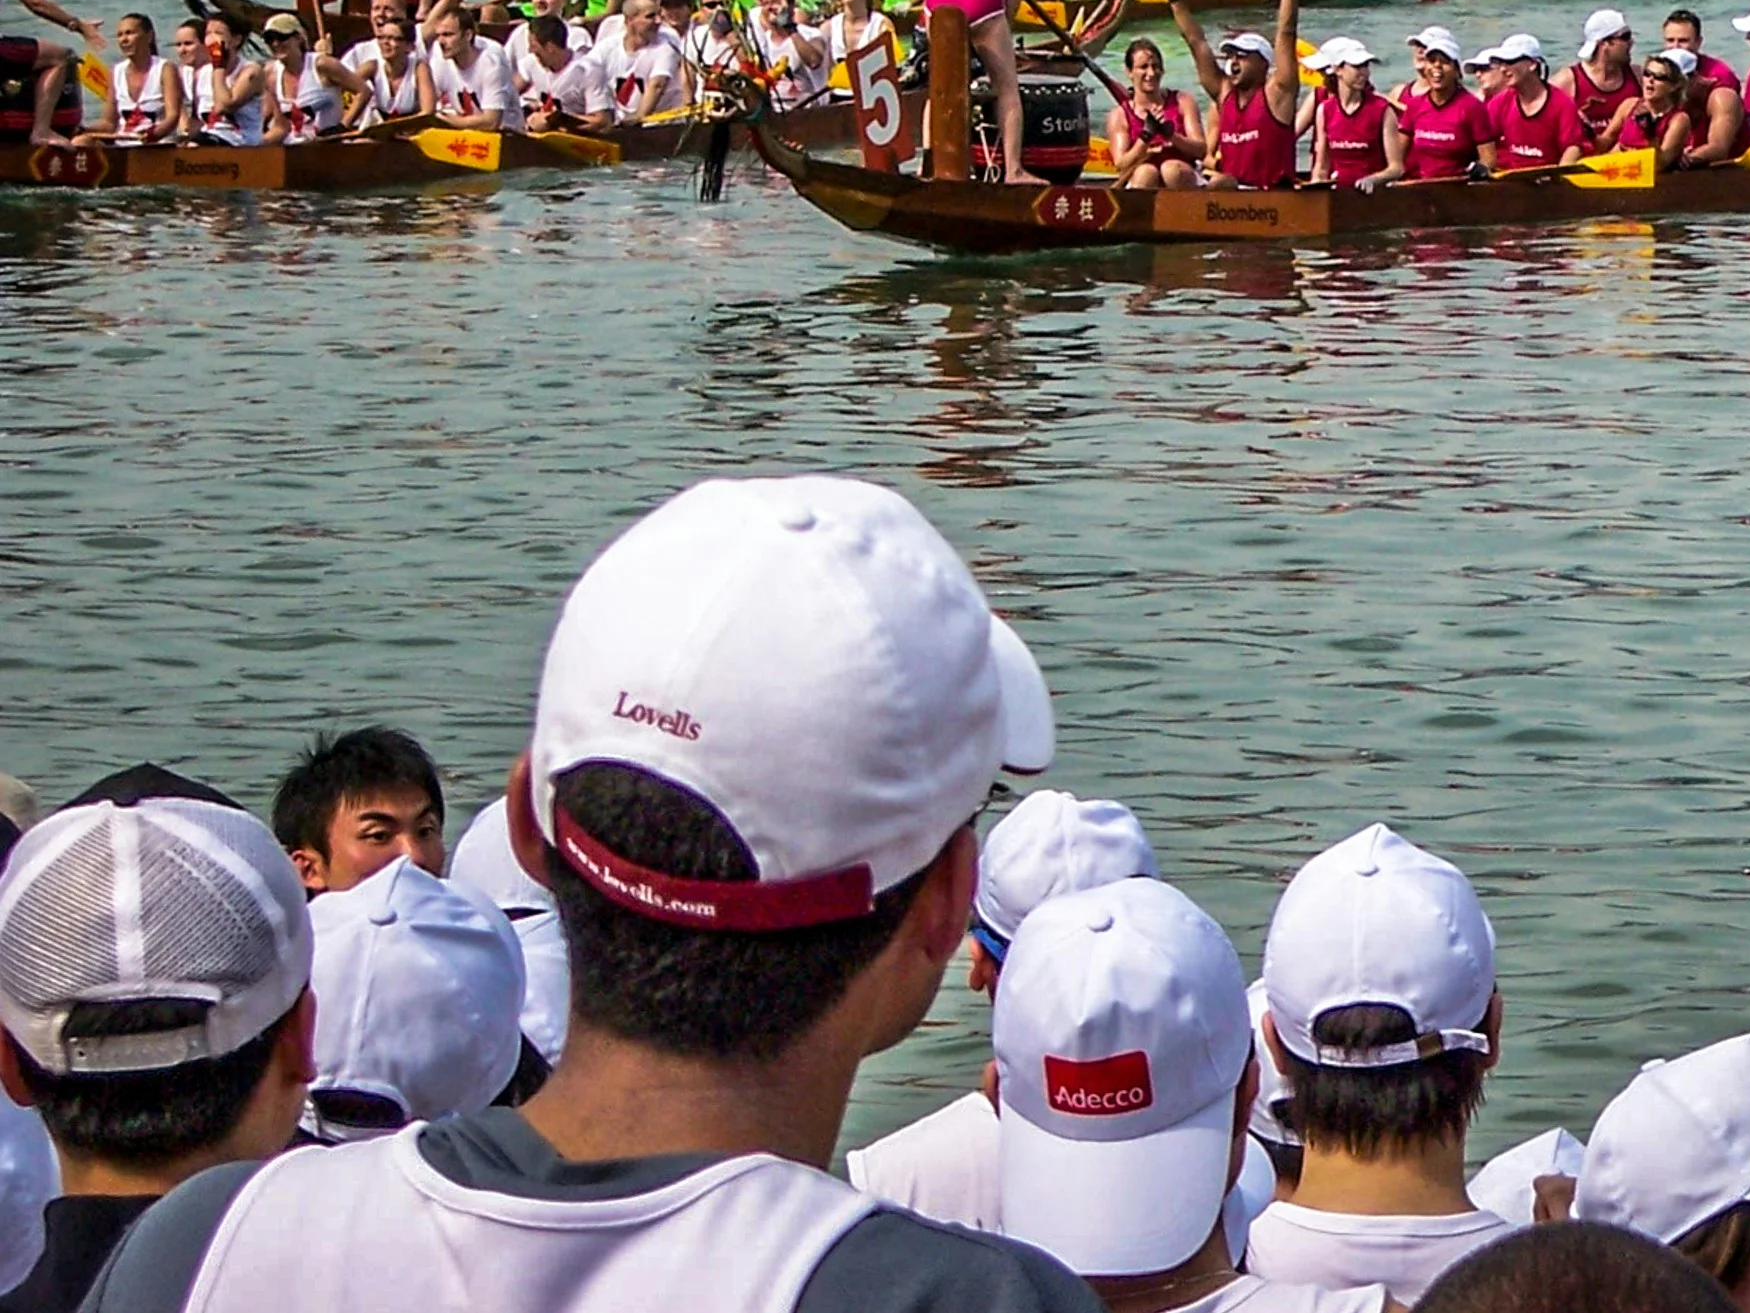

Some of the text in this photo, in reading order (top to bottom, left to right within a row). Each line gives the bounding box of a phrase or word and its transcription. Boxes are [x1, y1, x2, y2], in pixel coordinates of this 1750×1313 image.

[857, 44, 901, 146] 5
[1206, 200, 1280, 225] Bloomberg
[612, 690, 703, 741] Lovells
[565, 837, 717, 917] www.lovells.com
[1054, 1085, 1145, 1109] Adecco
